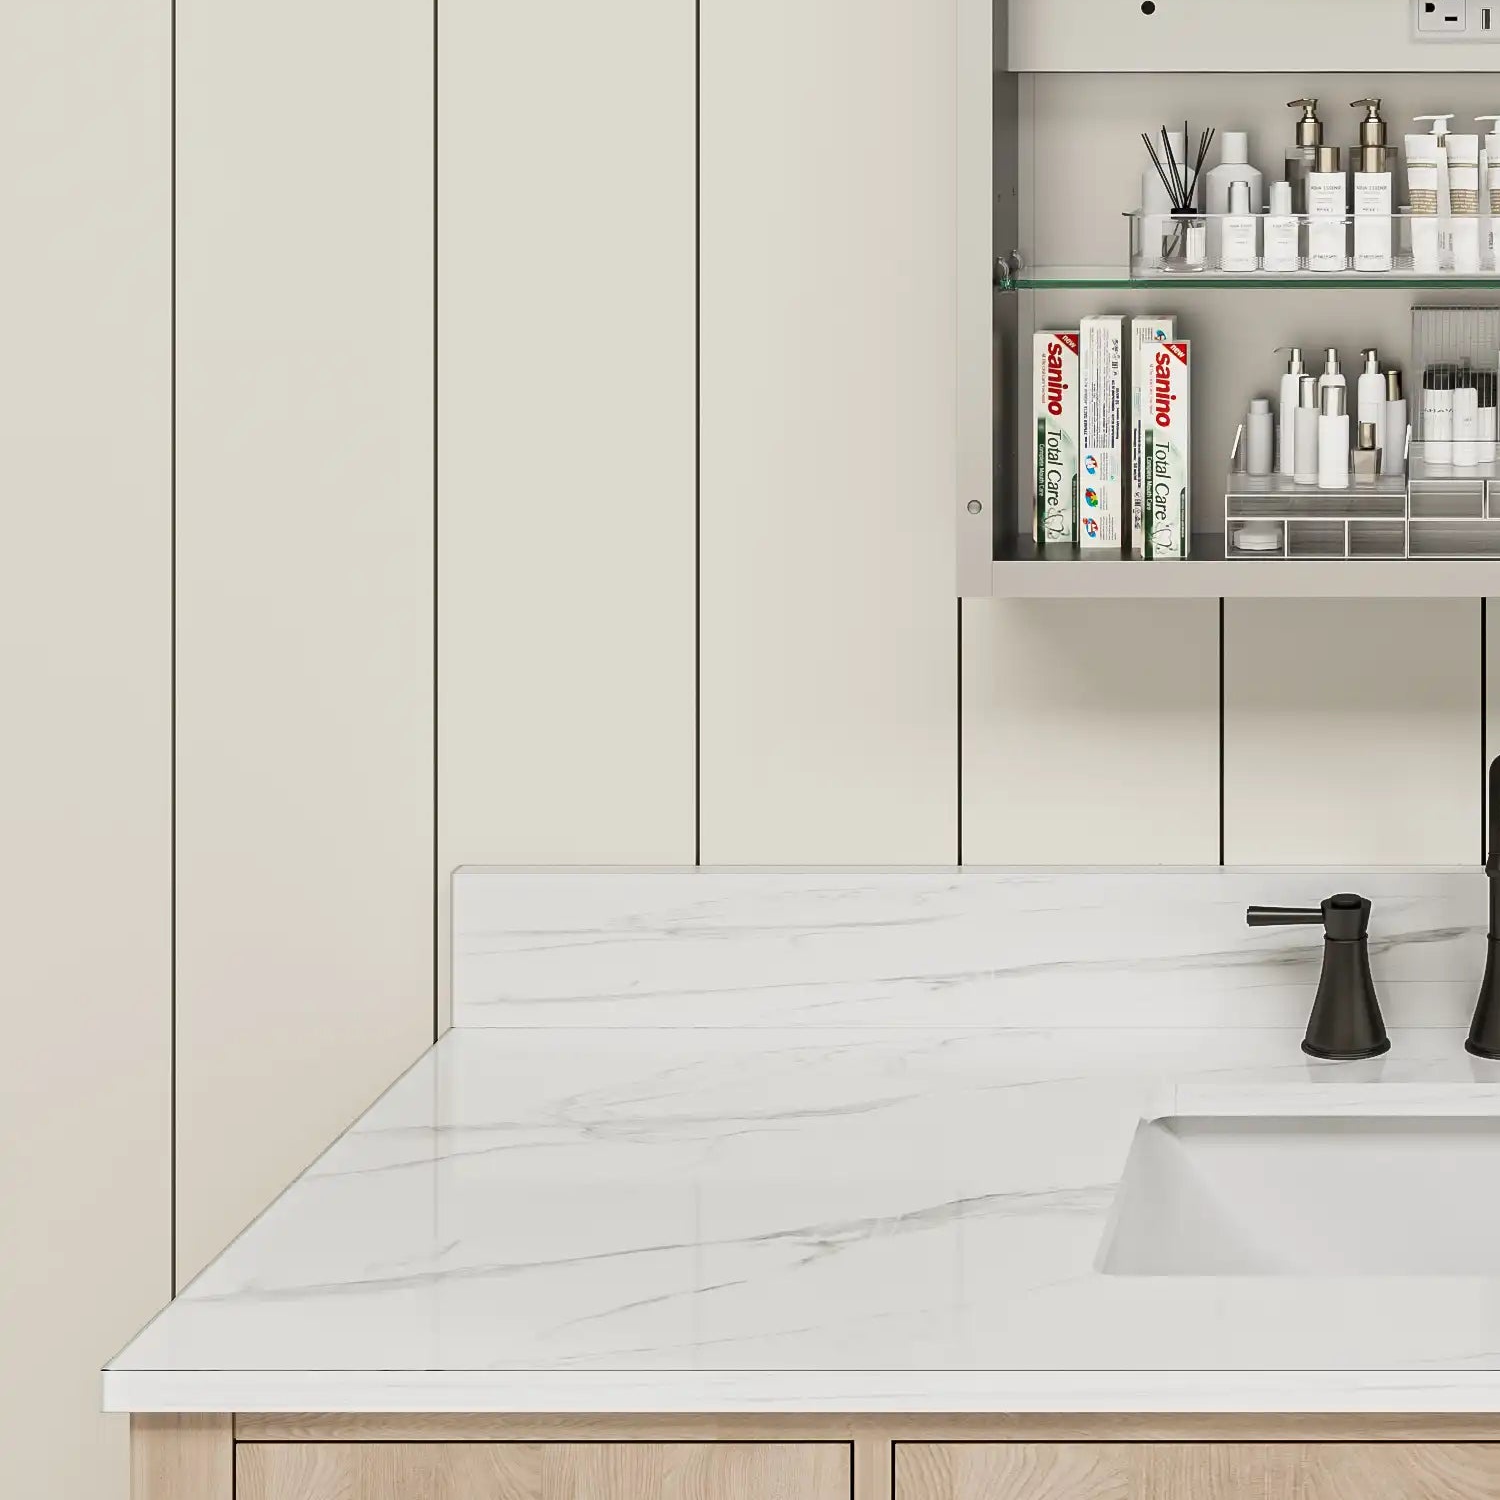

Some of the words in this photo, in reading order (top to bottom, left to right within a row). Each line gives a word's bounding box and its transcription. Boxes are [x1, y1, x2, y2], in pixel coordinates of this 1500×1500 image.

[1062, 335, 1077, 348] new
[1170, 344, 1186, 358] new
[1048, 342, 1069, 416] sanino
[1155, 351, 1177, 427] sanino
[1047, 429, 1063, 466] Total
[1155, 442, 1171, 479] Total
[1047, 469, 1062, 506] Care
[1155, 483, 1170, 521] Care
